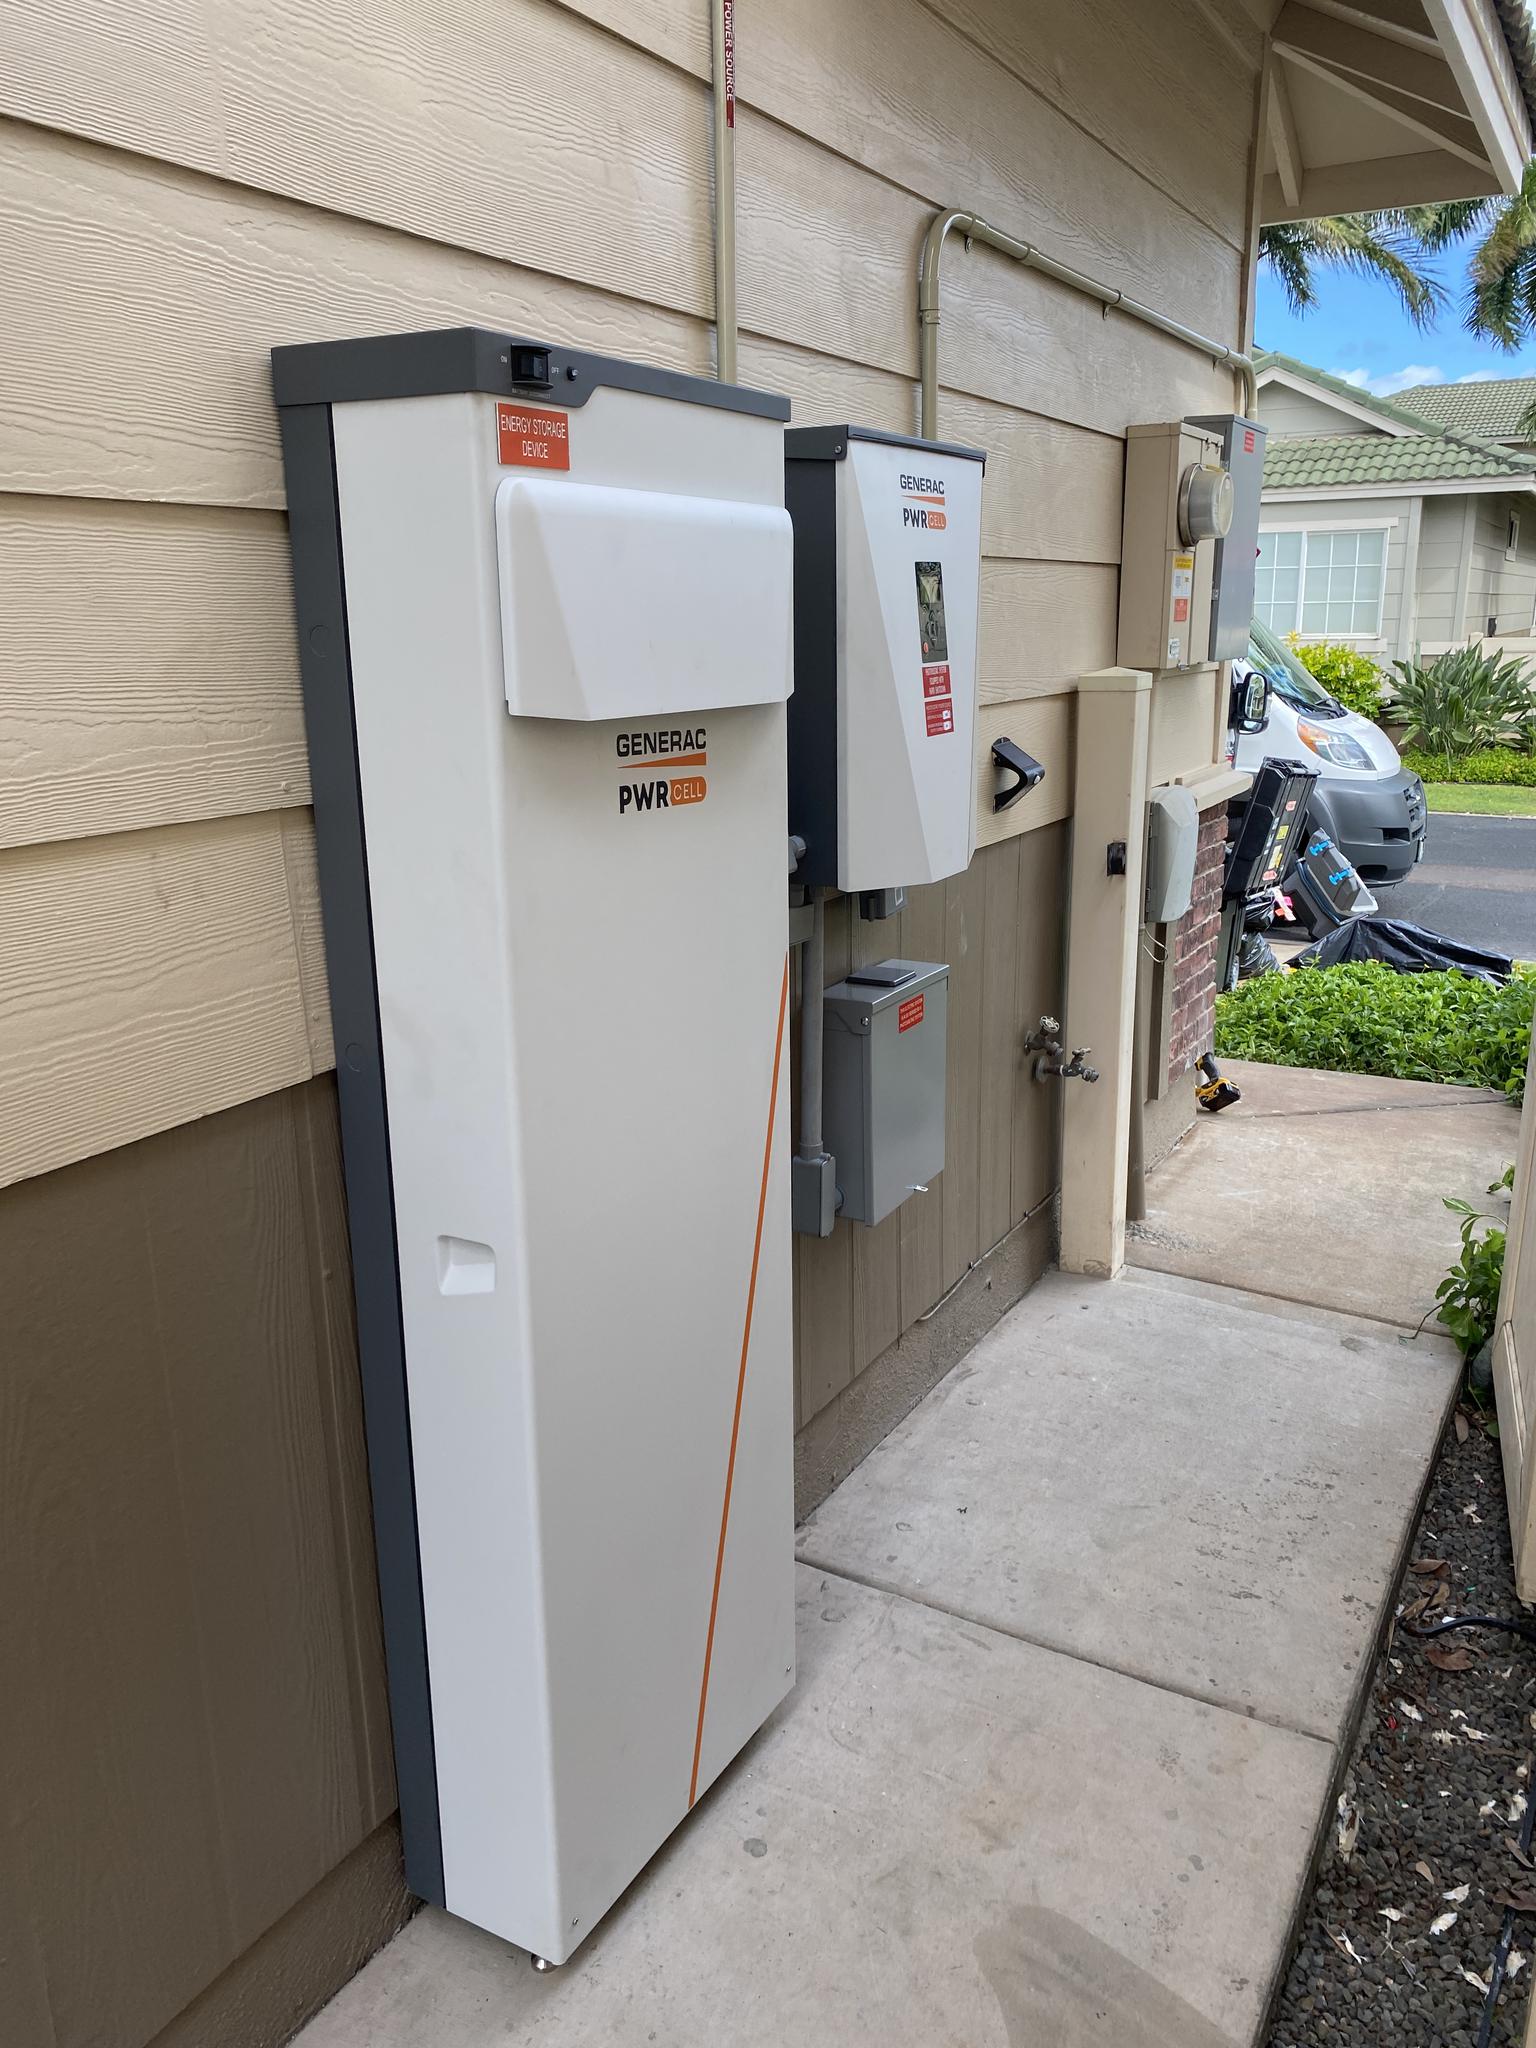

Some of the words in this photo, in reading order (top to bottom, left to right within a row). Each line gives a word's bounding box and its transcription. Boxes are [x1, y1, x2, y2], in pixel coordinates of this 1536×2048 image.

[724, 2, 733, 47] POWER
[725, 51, 734, 100] SOURCE
[501, 414, 531, 434] ENERGY
[533, 418, 566, 438] STORAGE
[522, 440, 548, 458] DEVICE
[899, 473, 945, 495] GENERAC
[616, 728, 707, 757] GENERAC
